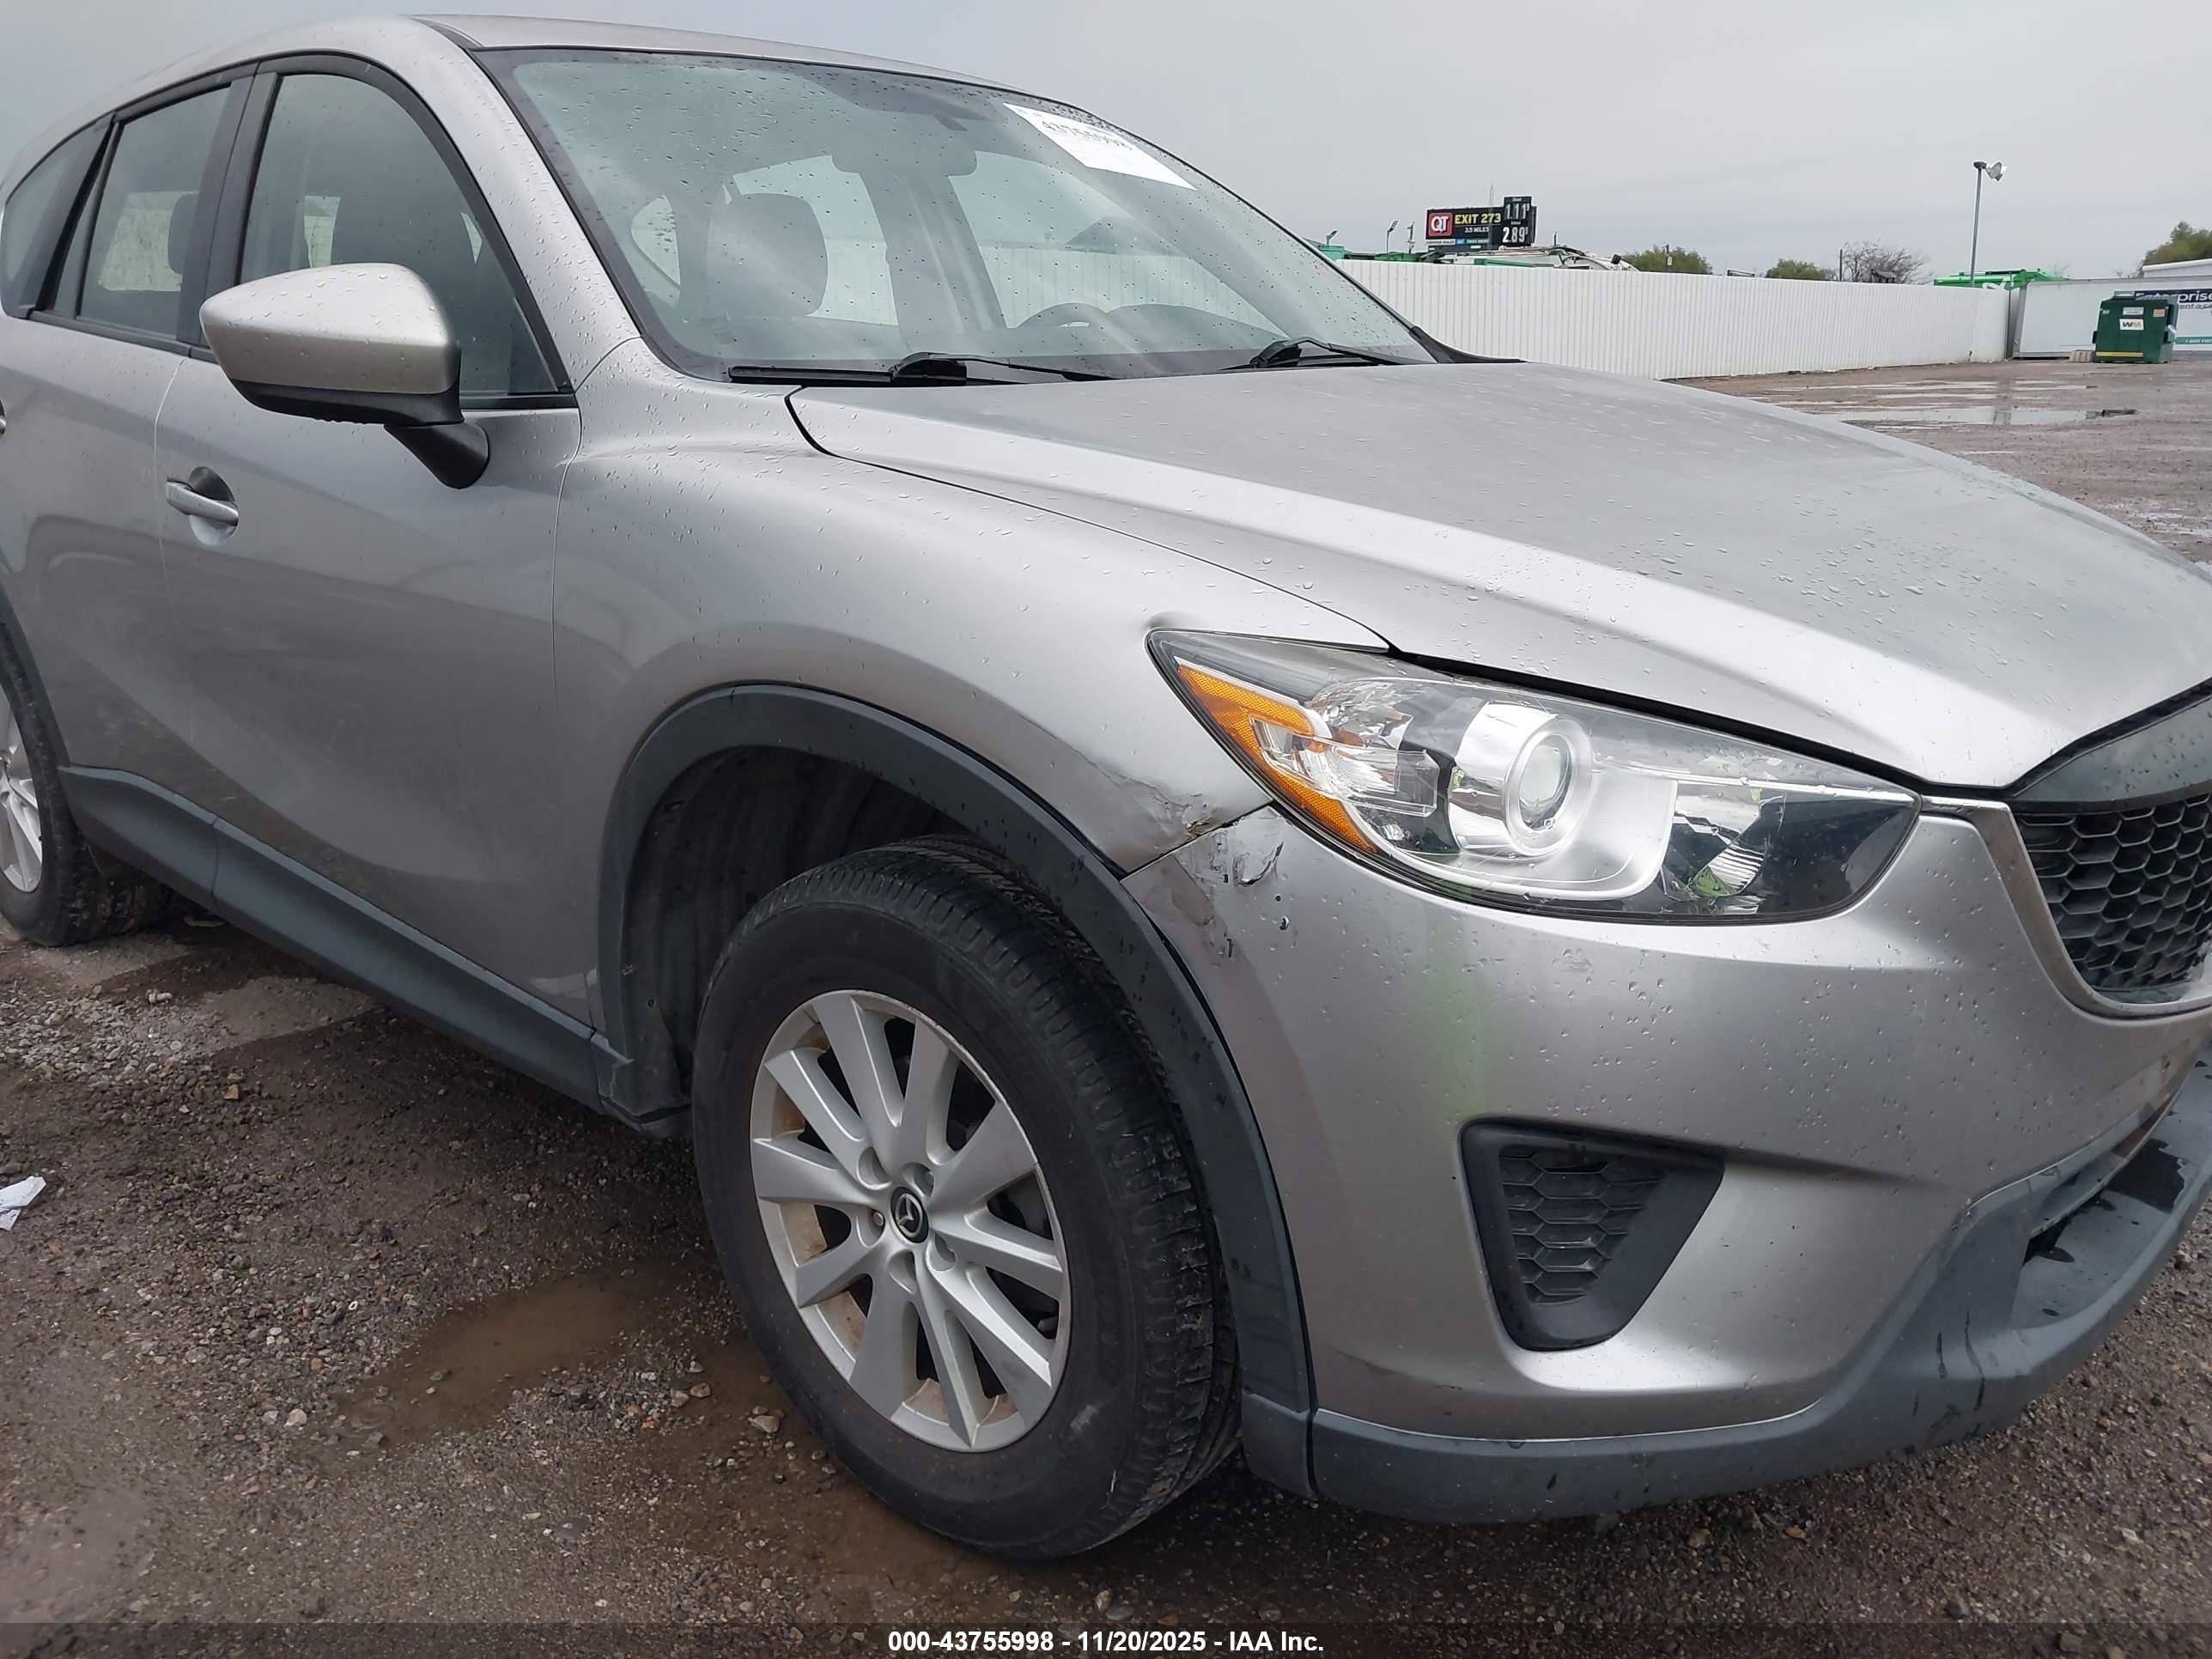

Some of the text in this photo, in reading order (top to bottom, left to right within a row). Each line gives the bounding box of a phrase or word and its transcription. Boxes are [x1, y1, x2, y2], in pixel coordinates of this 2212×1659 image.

[1431, 216, 1449, 233] QT
[1455, 213, 1502, 224] EXIT 273
